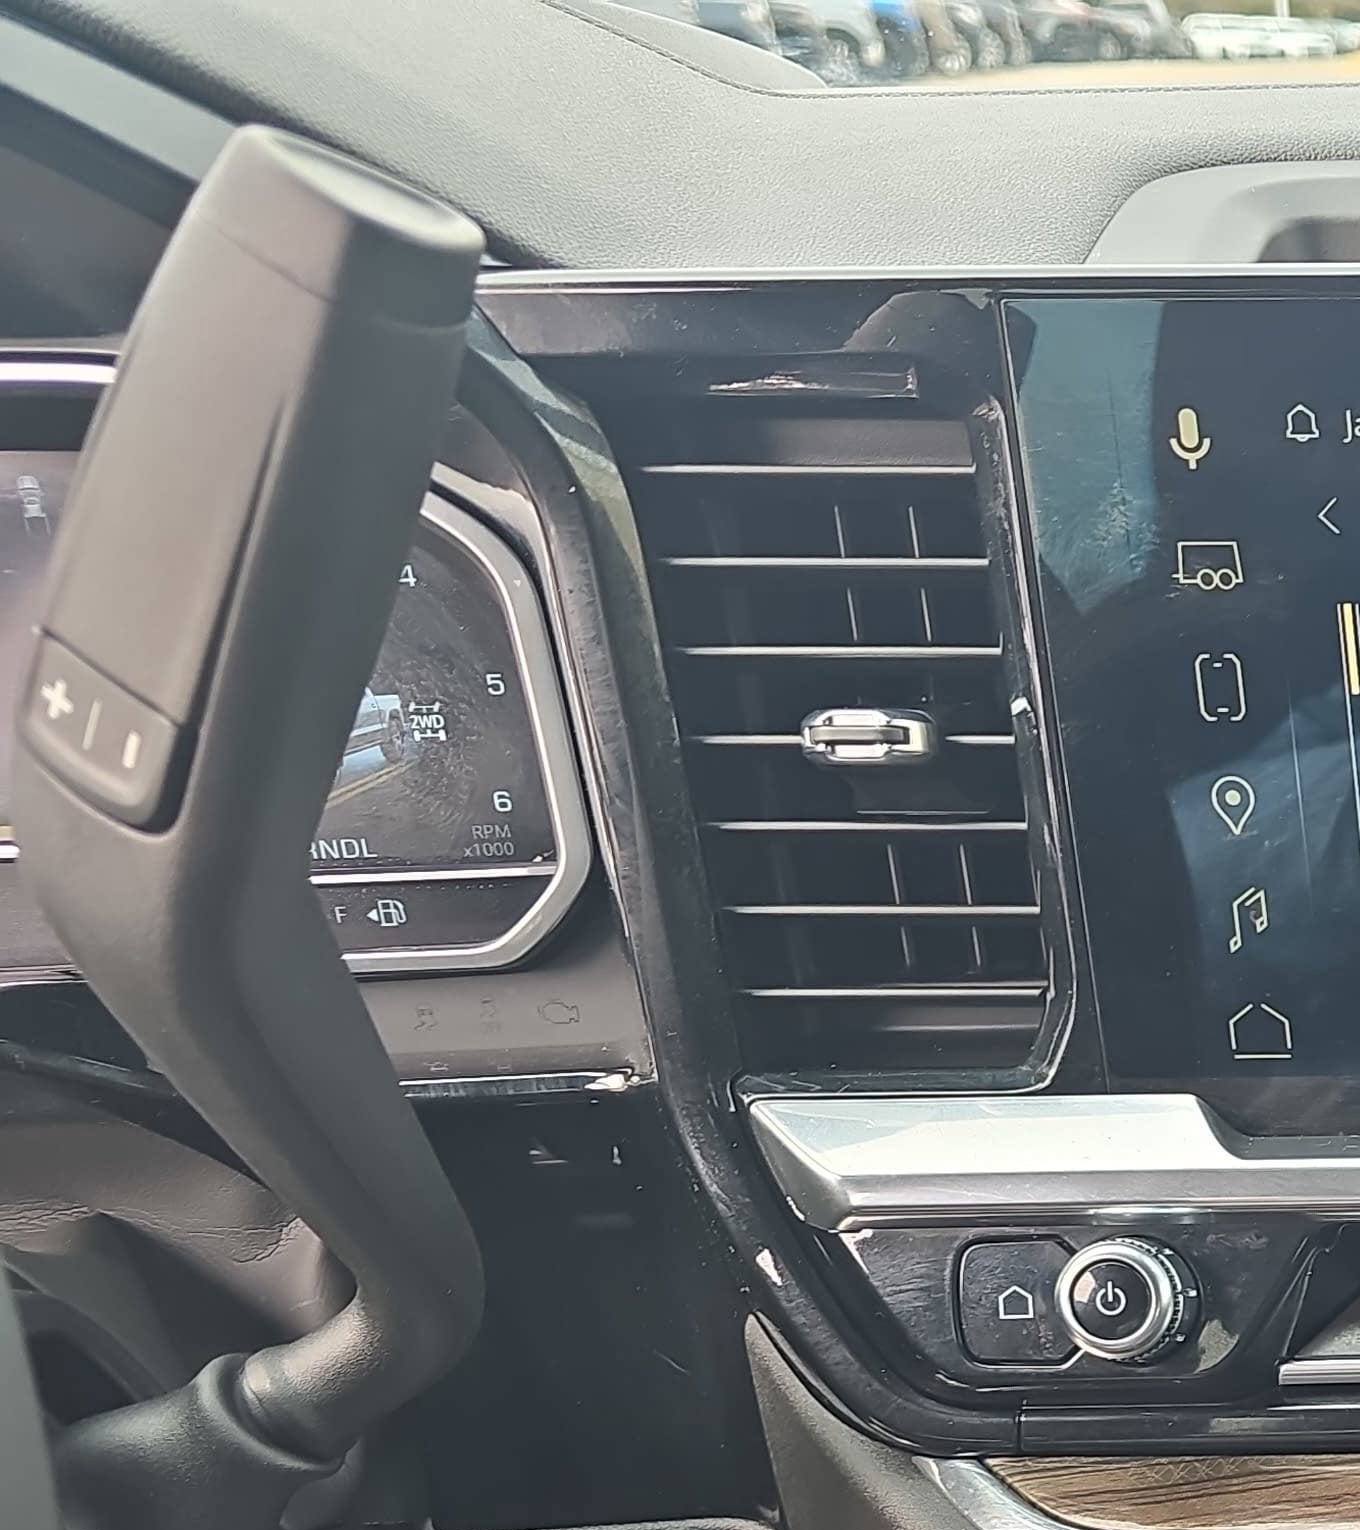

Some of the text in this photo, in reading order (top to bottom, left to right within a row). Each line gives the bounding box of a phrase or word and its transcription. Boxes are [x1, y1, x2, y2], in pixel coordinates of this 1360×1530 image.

[485, 673, 506, 696] 5
[410, 713, 446, 730] 2WD
[493, 789, 513, 813] 6
[471, 824, 512, 839] RPM
[463, 841, 514, 858] x1000
[334, 905, 348, 924] F
